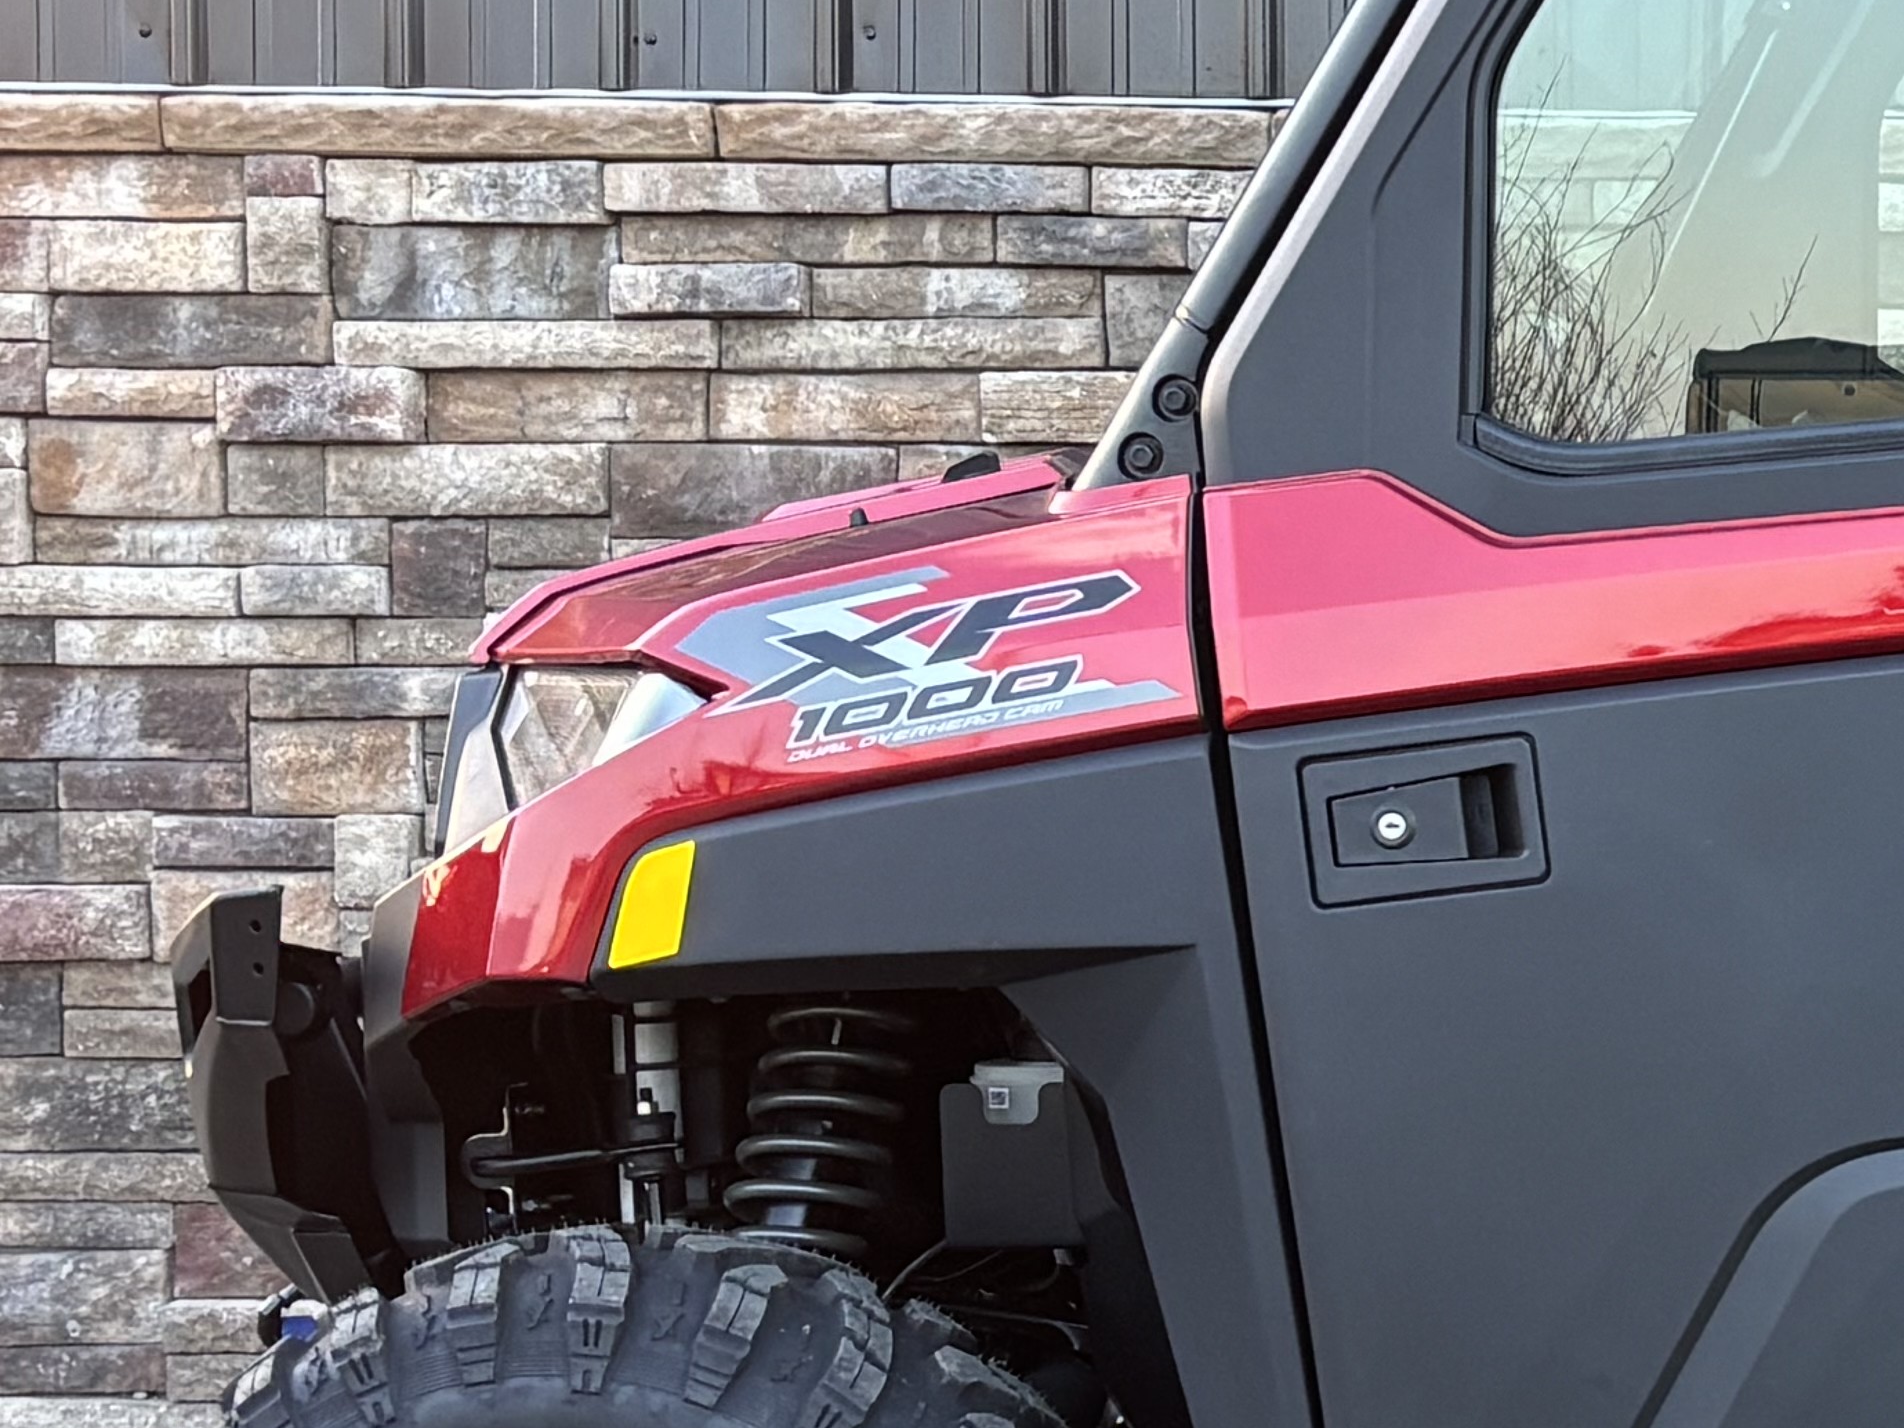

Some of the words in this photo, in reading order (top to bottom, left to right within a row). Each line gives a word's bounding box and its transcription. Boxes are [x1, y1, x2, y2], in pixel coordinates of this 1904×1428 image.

[704, 570, 1141, 718] XP
[786, 654, 1084, 750] 1000
[786, 739, 853, 764] DUAL
[858, 711, 999, 749] OVERHEAD
[1003, 699, 1064, 721] CAM
